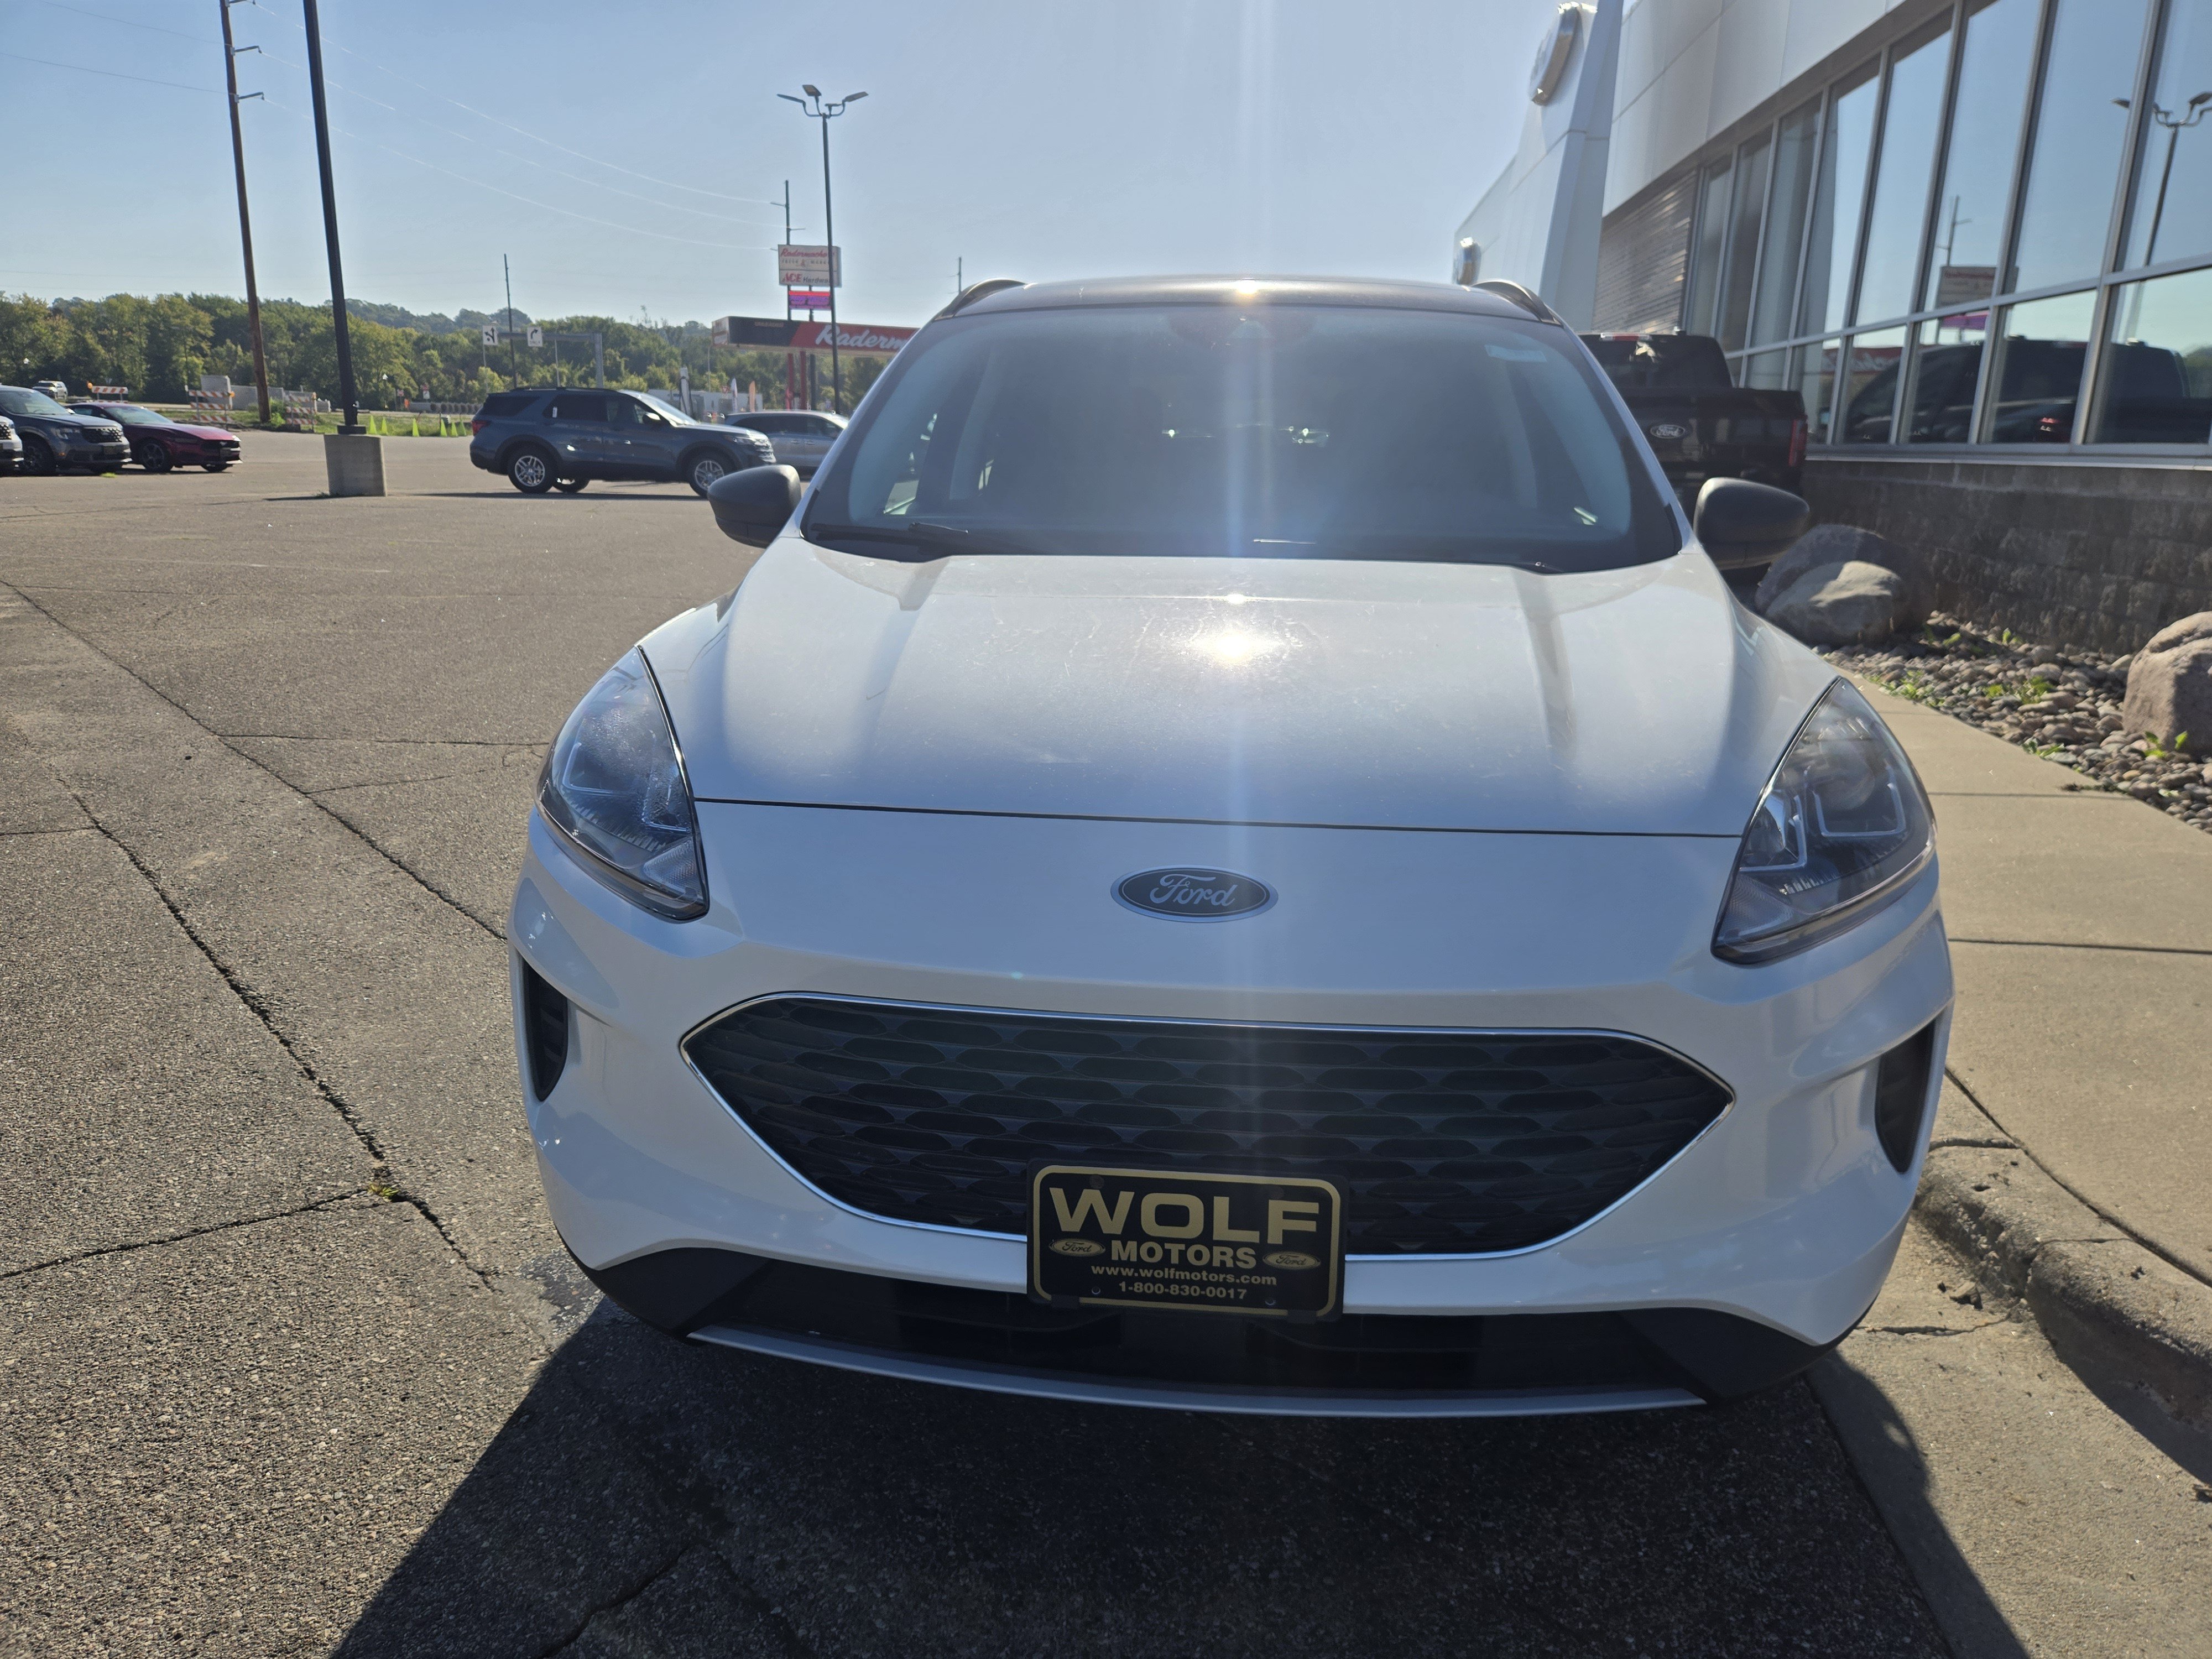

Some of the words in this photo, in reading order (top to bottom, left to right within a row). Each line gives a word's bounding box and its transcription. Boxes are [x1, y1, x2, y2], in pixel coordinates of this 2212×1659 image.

[782, 272, 803, 282] ACE
[815, 324, 909, 349] Raderm
[1150, 874, 1238, 906] Ford
[1048, 1187, 1320, 1245] WOLF
[1062, 1241, 1092, 1253] Ford
[1111, 1239, 1257, 1270] MOTORS
[1275, 1254, 1307, 1265] Ford
[1091, 1265, 1277, 1286] www.wolfmotors.com
[1118, 1281, 1248, 1300] 1-800-830-0017
